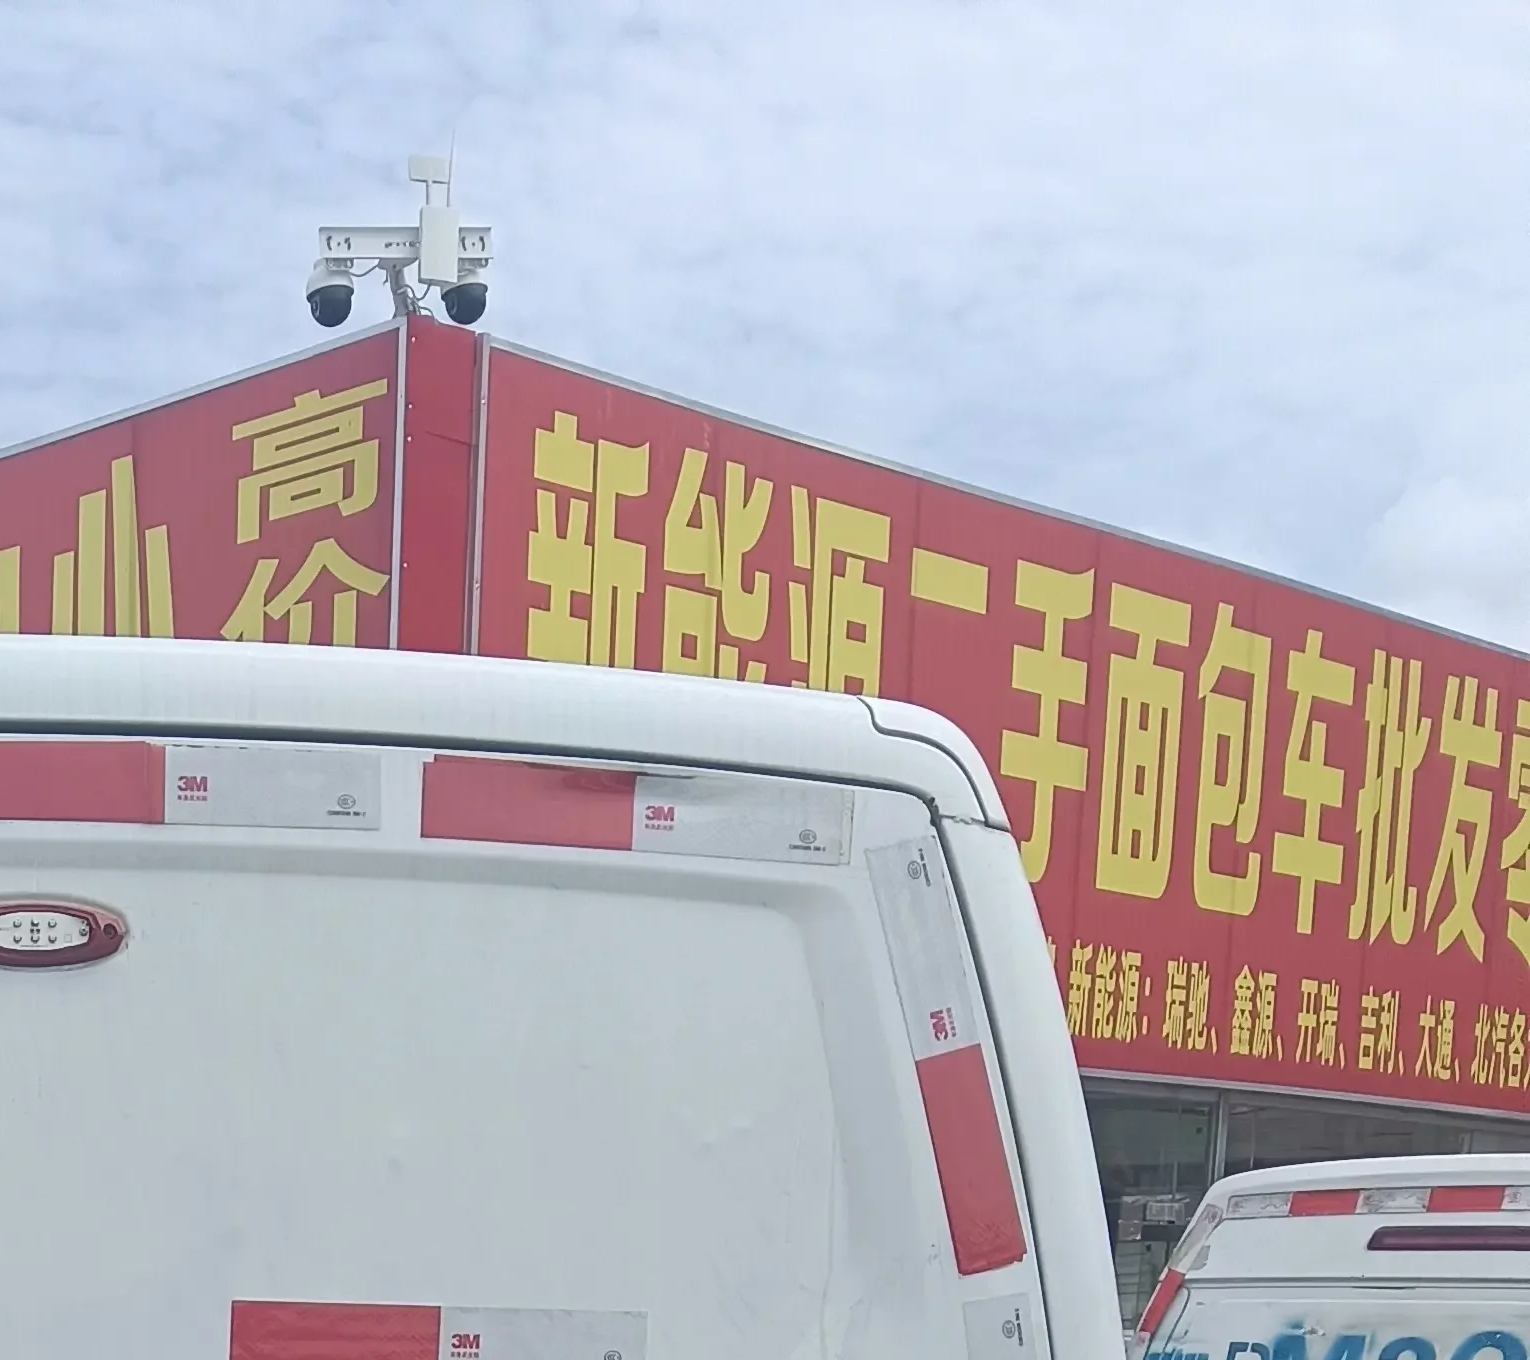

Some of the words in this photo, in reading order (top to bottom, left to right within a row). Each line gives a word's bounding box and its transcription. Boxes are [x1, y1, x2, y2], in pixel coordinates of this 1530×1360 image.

[220, 378, 390, 646] 高价
[177, 776, 208, 792] 3M
[645, 805, 674, 822] 3M
[929, 1010, 948, 1042] 3M
[450, 1333, 480, 1349] 3M
